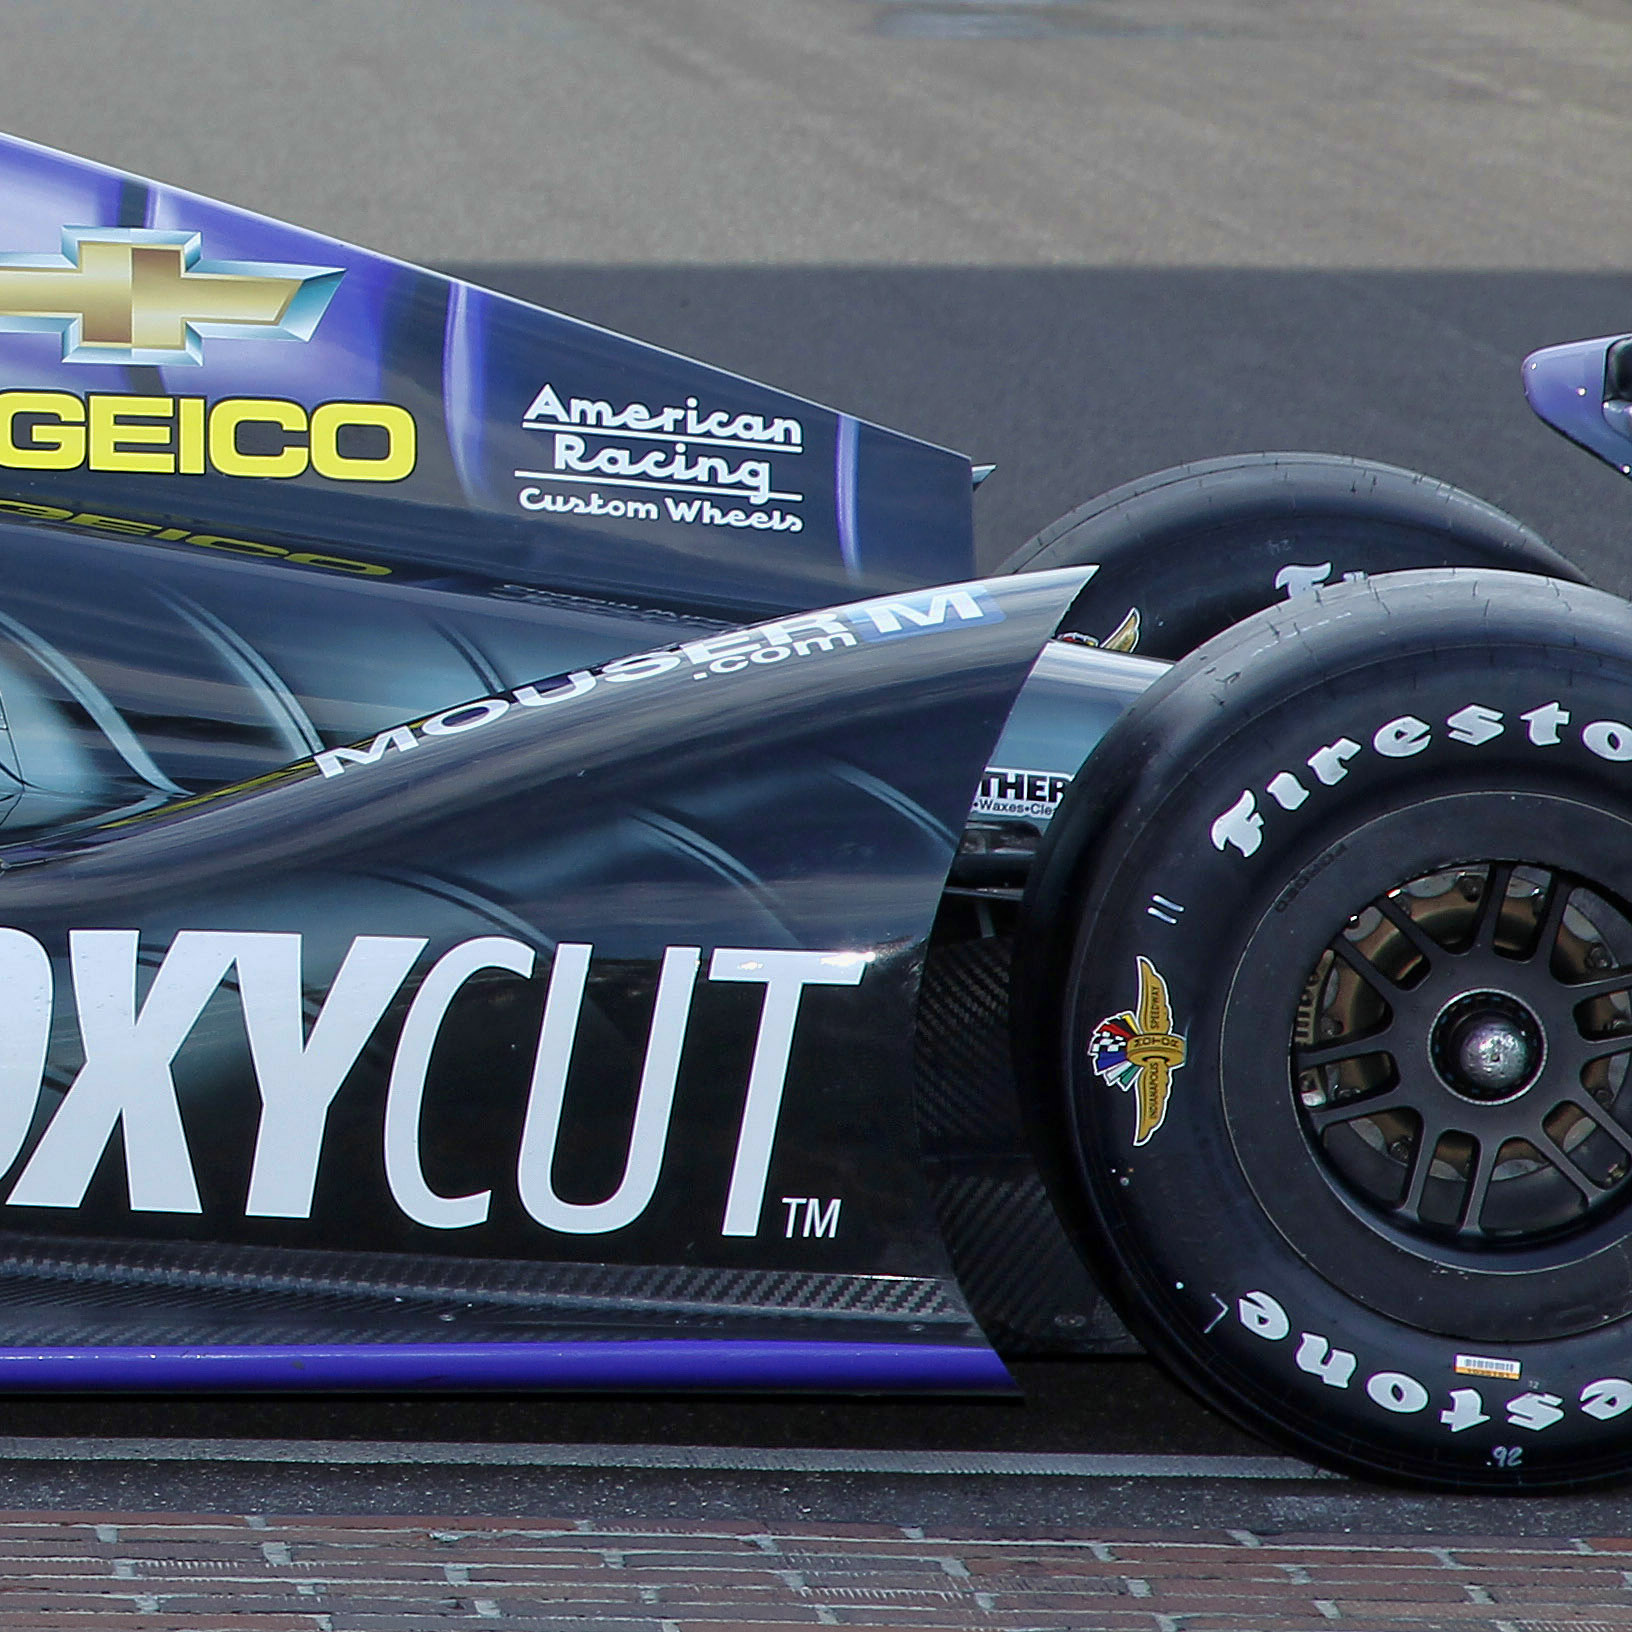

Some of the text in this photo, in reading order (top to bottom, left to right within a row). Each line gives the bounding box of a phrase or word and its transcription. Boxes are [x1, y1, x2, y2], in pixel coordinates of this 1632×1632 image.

[524, 383, 803, 445] American
[553, 433, 770, 505] Racing
[519, 487, 803, 532] Custom Wheels
[693, 631, 858, 681] .com
[313, 608, 851, 780] MOUSER
[1150, 985, 1162, 1029] SPEEDWAY
[1133, 1036, 1179, 1048] MOTOR
